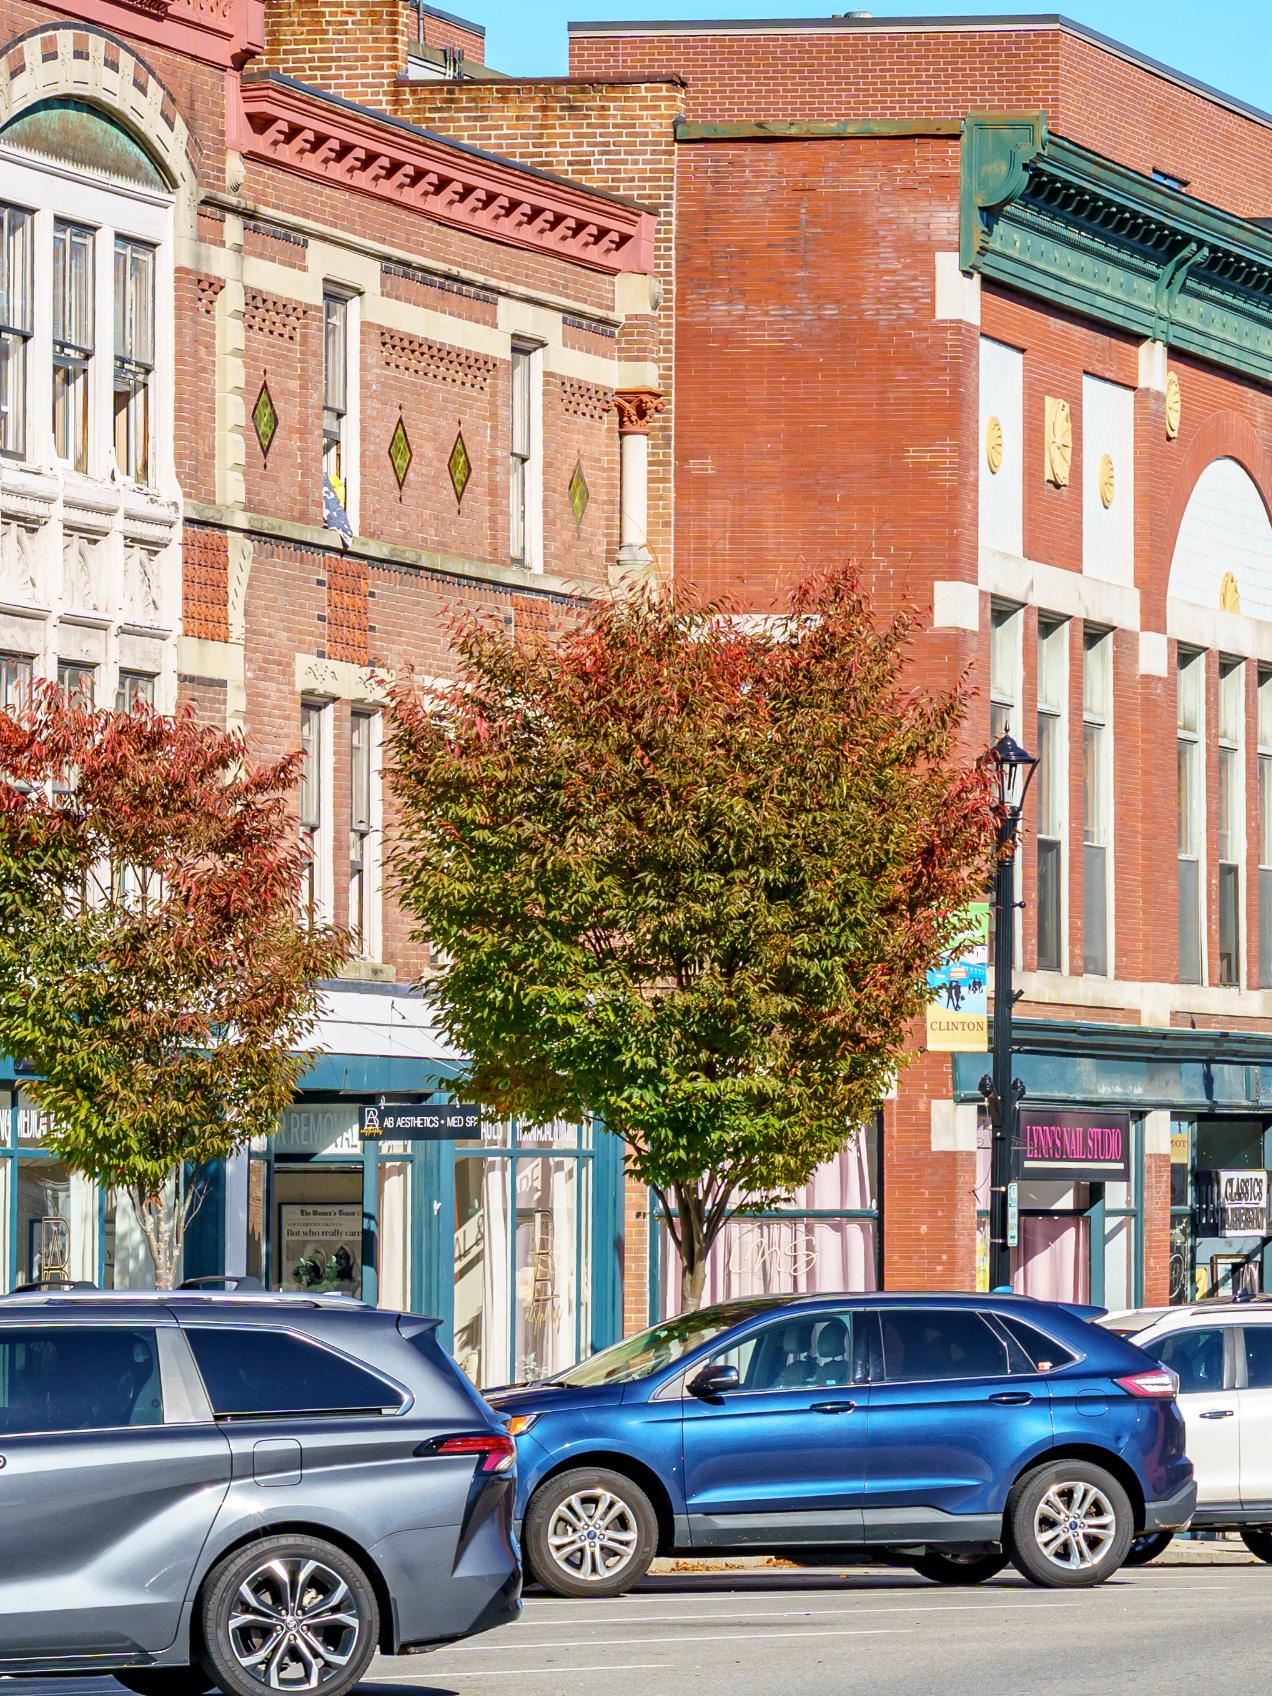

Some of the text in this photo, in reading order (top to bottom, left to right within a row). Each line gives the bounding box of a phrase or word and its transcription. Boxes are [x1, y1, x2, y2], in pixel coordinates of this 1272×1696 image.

[930, 1021, 985, 1032] CLINTON
[383, 1116, 395, 1128] AB
[396, 1116, 439, 1128] AESTHETICS
[447, 1116, 464, 1127] MED
[1026, 1126, 1122, 1160] LYNN'S NAIL STUDIO
[1225, 1177, 1263, 1202] CLASSICS
[286, 1229, 300, 1237] But
[302, 1229, 320, 1237] who
[321, 1229, 344, 1239] really
